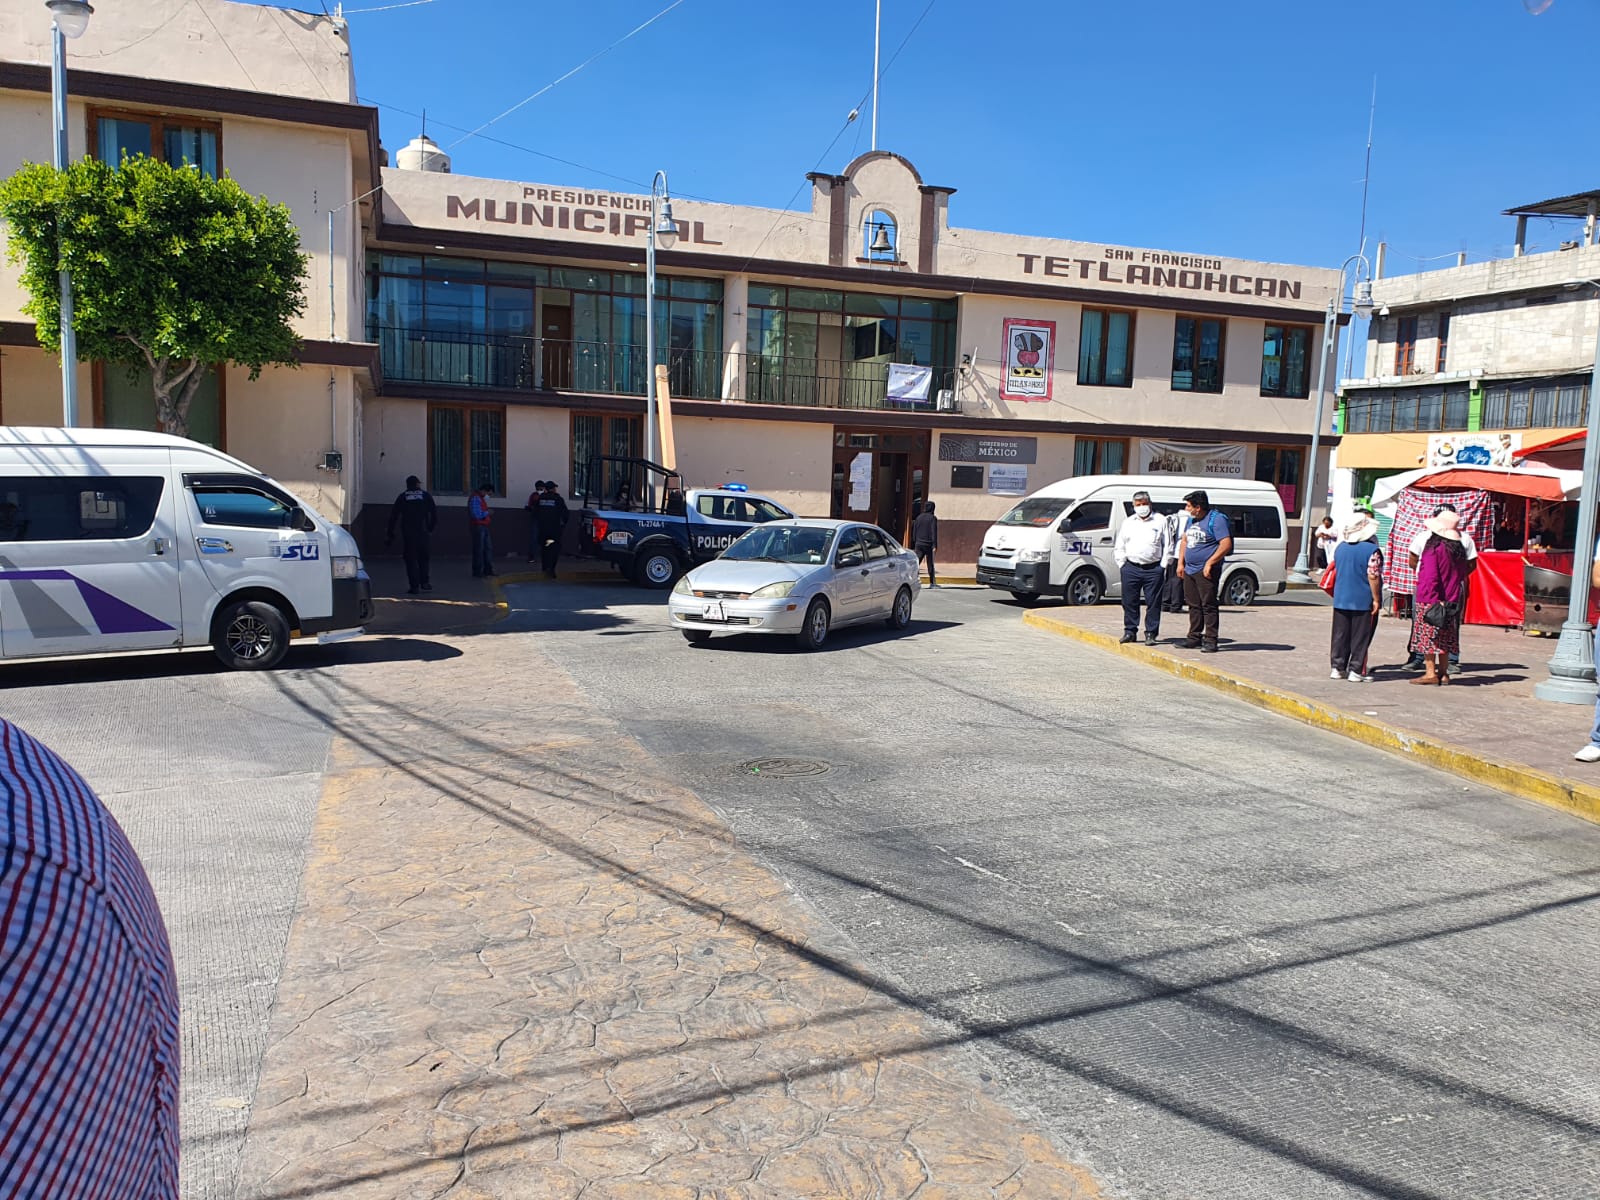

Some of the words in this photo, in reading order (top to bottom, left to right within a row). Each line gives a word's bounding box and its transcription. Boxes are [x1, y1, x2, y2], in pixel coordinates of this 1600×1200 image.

[523, 187, 653, 212] PRESIDENCIA
[1104, 248, 1134, 261] SAN
[1142, 252, 1222, 271] FRANCISCO
[1017, 253, 1302, 300] TETLANOHCAN
[978, 447, 1017, 457] MÉXICO
[1205, 464, 1241, 474] MÉXICO
